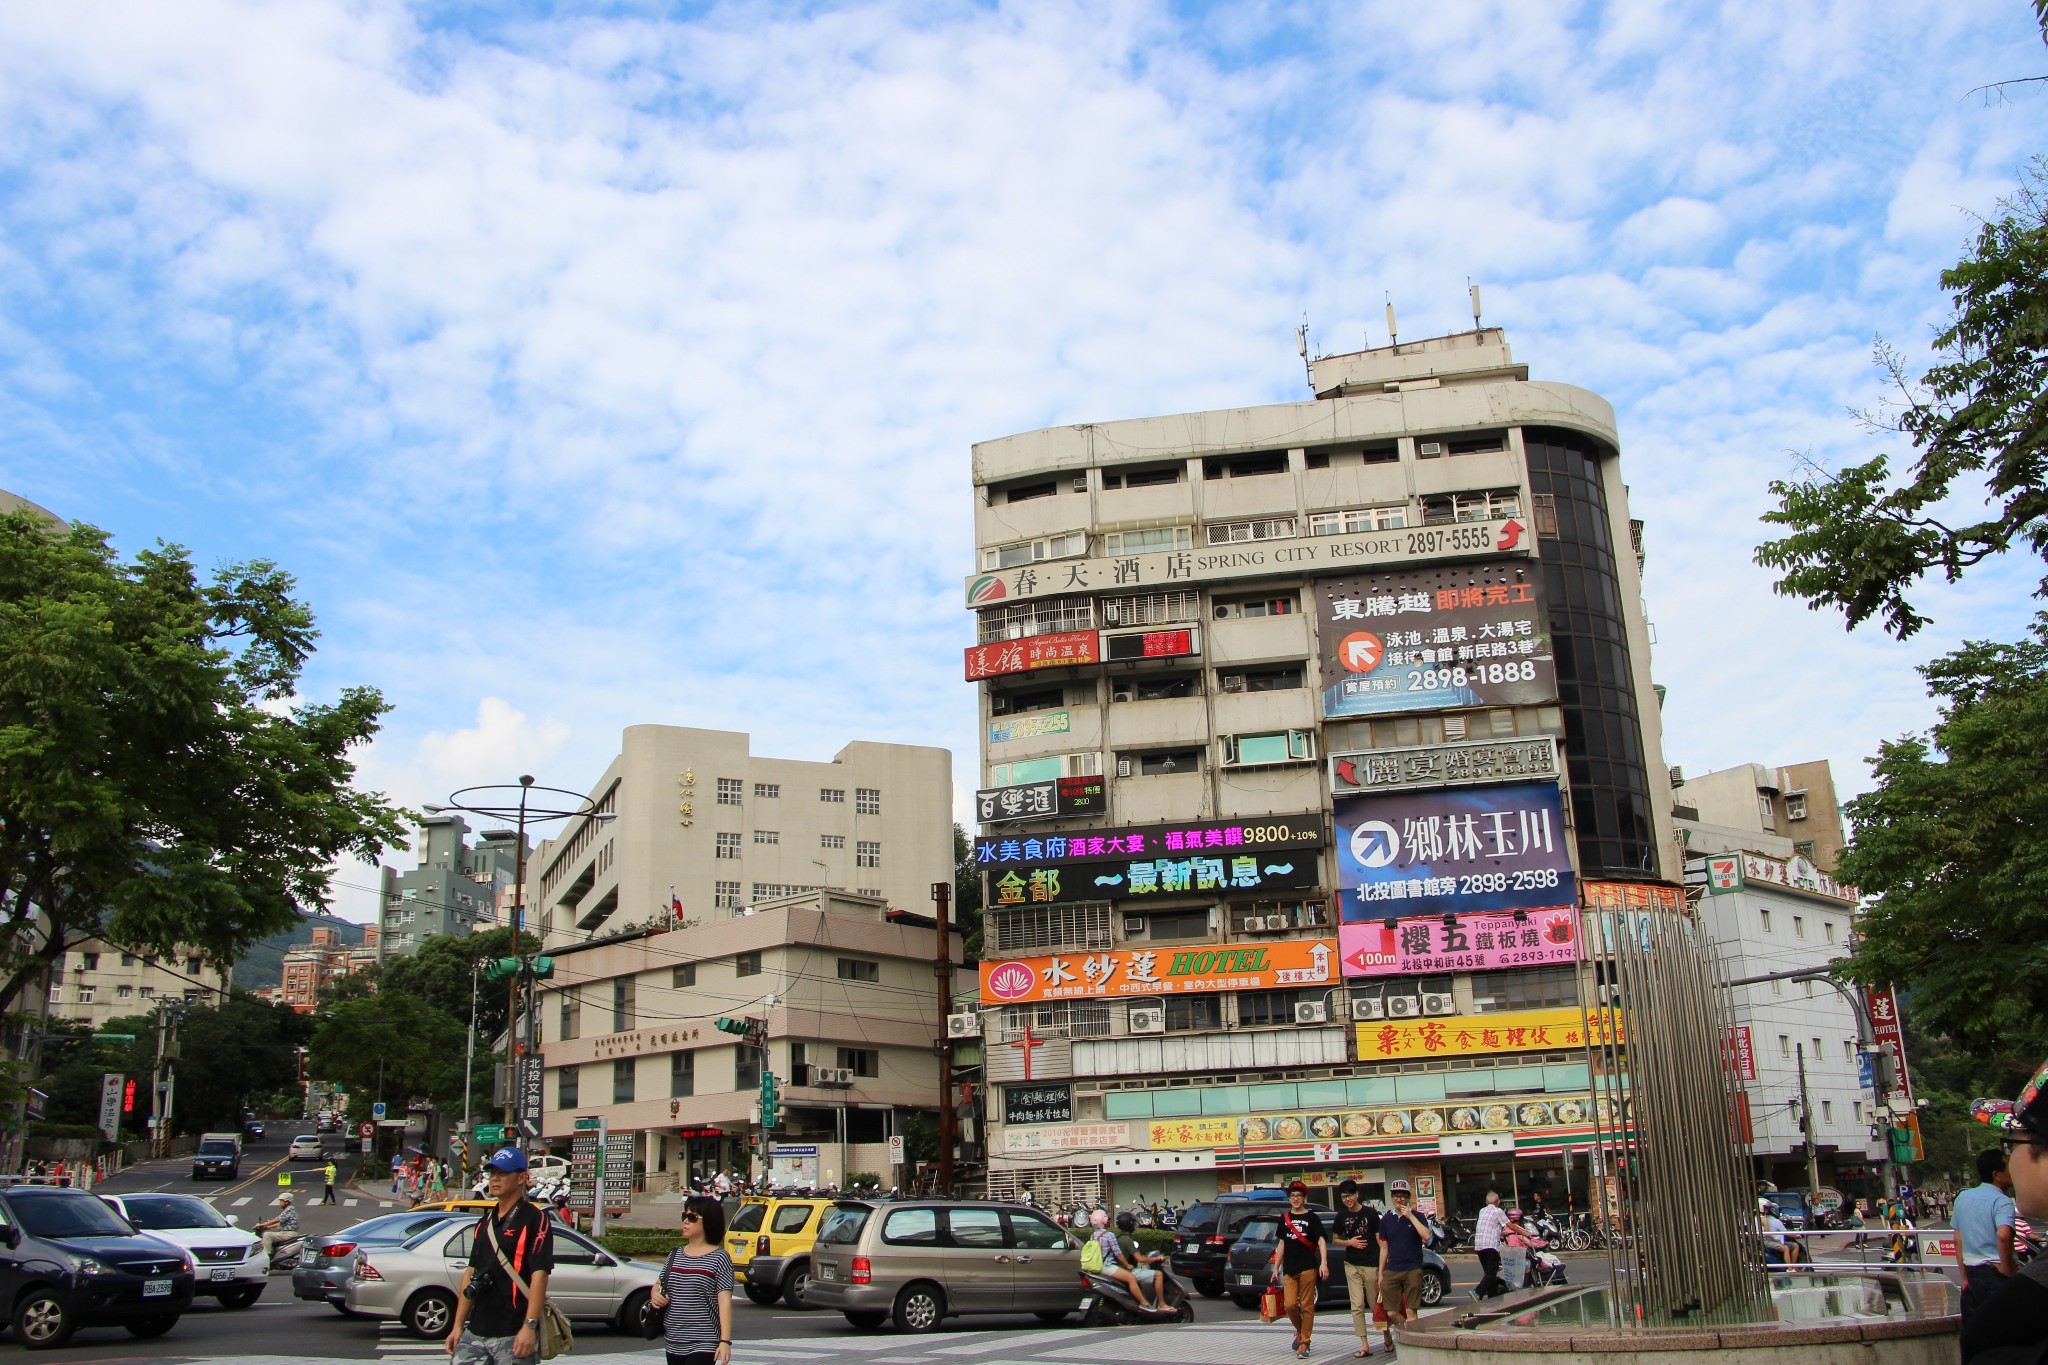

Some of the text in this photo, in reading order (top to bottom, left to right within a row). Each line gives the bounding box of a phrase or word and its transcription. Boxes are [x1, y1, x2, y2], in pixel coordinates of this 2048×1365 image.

[1197, 550, 1265, 571] SPRING
[1274, 544, 1319, 563] CITY
[1330, 537, 1403, 558] RESORT
[1407, 526, 1490, 555] 2897-5555
[1436, 583, 1536, 611] 即將完工
[1030, 643, 1090, 660] 時尚溫泉
[1458, 639, 1535, 661] 新民路3巷
[1407, 661, 1537, 692] 2898-1888
[1445, 742, 1551, 768] 婚宴會館
[1447, 762, 1551, 780] 2891-8899
[977, 836, 1067, 863] 水美食府
[1243, 825, 1290, 844] 9800
[1290, 831, 1317, 841] +10%
[1402, 808, 1553, 864] 鄉林玉川
[996, 868, 1060, 904] 金都
[1356, 868, 1559, 902] 北投圖書館旁 2898-2598
[1791, 875, 1818, 892] HOTEL
[1474, 916, 1538, 931] Teppanyaki
[1401, 922, 1471, 956] 櫻五
[1475, 929, 1541, 951] 鐵板燒
[1167, 948, 1271, 976] HOTEL
[1315, 952, 1327, 975] 本棟
[1357, 952, 1397, 966] 100m
[1873, 998, 1893, 1020] 蓮
[1875, 1024, 1898, 1035] HOTEL
[527, 1058, 541, 1118] 北投文物館
[1900, 1186, 1909, 1196] P
